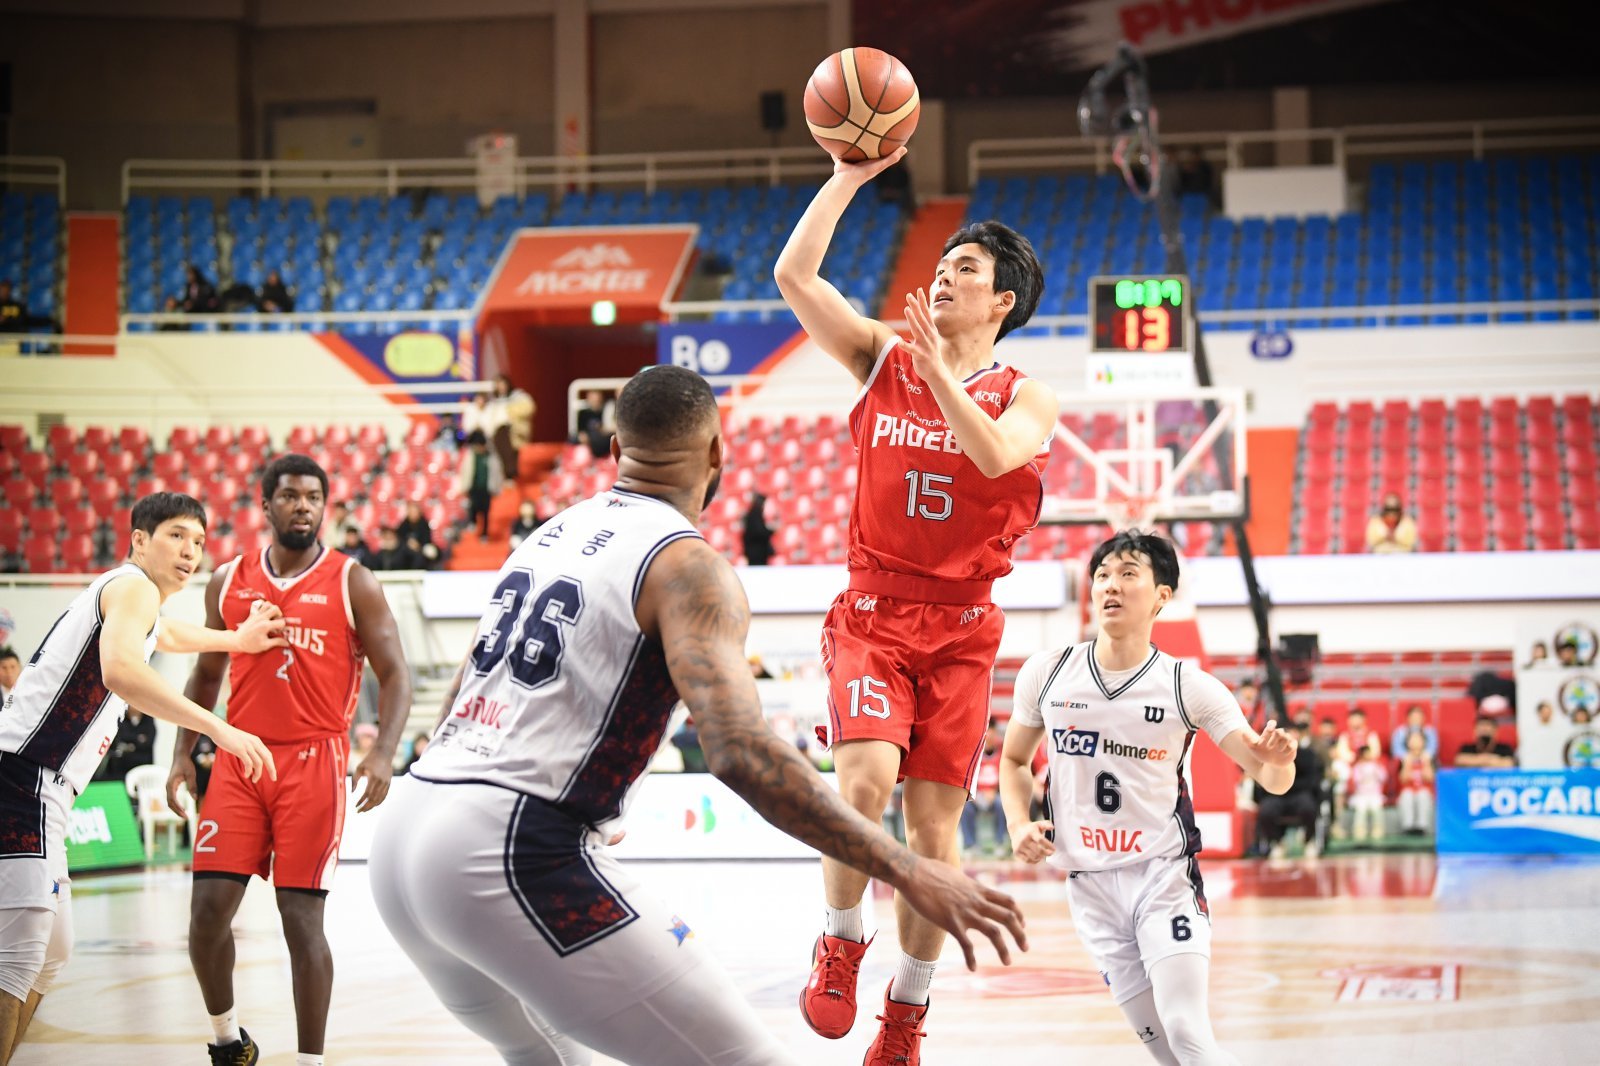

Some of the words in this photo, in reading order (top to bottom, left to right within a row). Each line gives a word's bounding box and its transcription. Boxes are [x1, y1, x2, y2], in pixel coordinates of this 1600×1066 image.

[1125, 307, 1170, 352] 13
[872, 413, 963, 454] PHOEB
[904, 469, 953, 522] 15
[470, 566, 585, 690] 36
[275, 649, 294, 683] 2
[846, 675, 891, 720] 15
[1054, 726, 1095, 754] KCC
[1103, 738, 1168, 761] Homecc
[1094, 770, 1122, 815] 6
[195, 819, 219, 852] 2
[1079, 826, 1143, 853] BNK
[1171, 915, 1193, 942] 6
